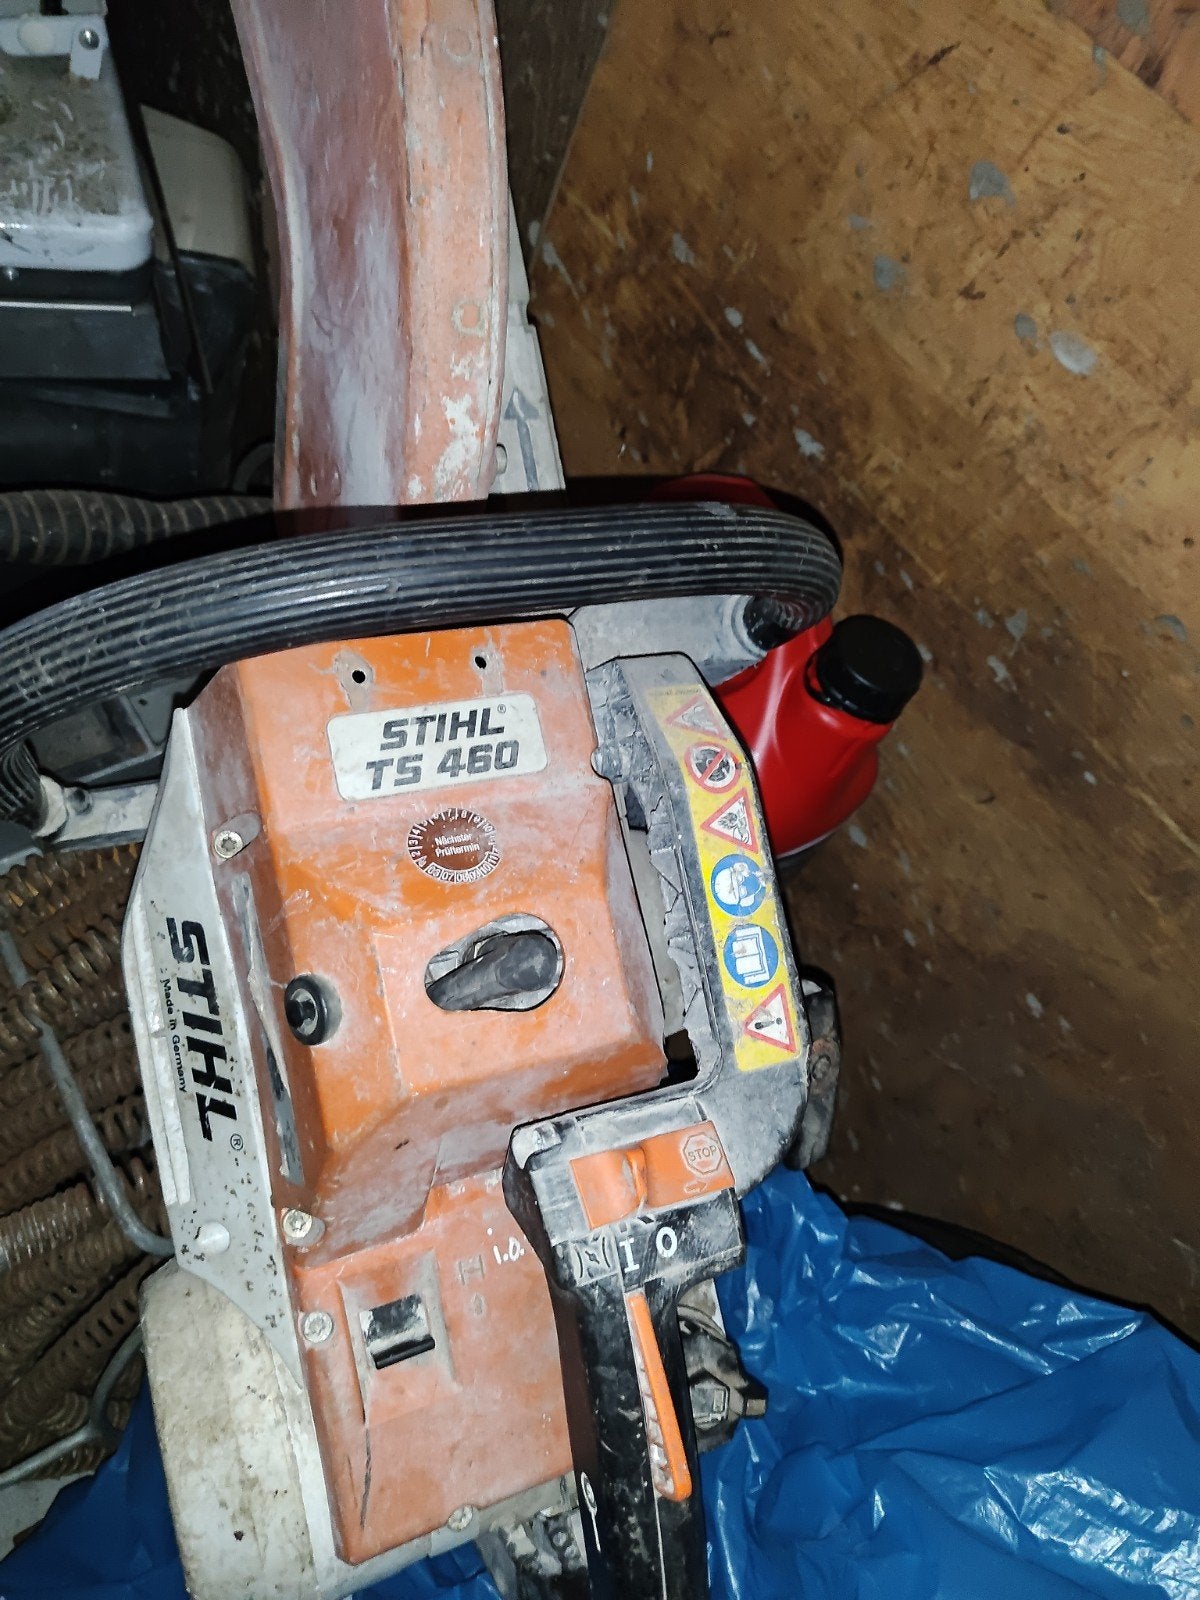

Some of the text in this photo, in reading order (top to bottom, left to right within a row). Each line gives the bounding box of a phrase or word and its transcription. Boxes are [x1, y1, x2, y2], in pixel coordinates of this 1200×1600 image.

[366, 740, 520, 791] TS 460
[160, 978, 188, 1094] Made in Germany
[687, 1144, 718, 1163] STOP
